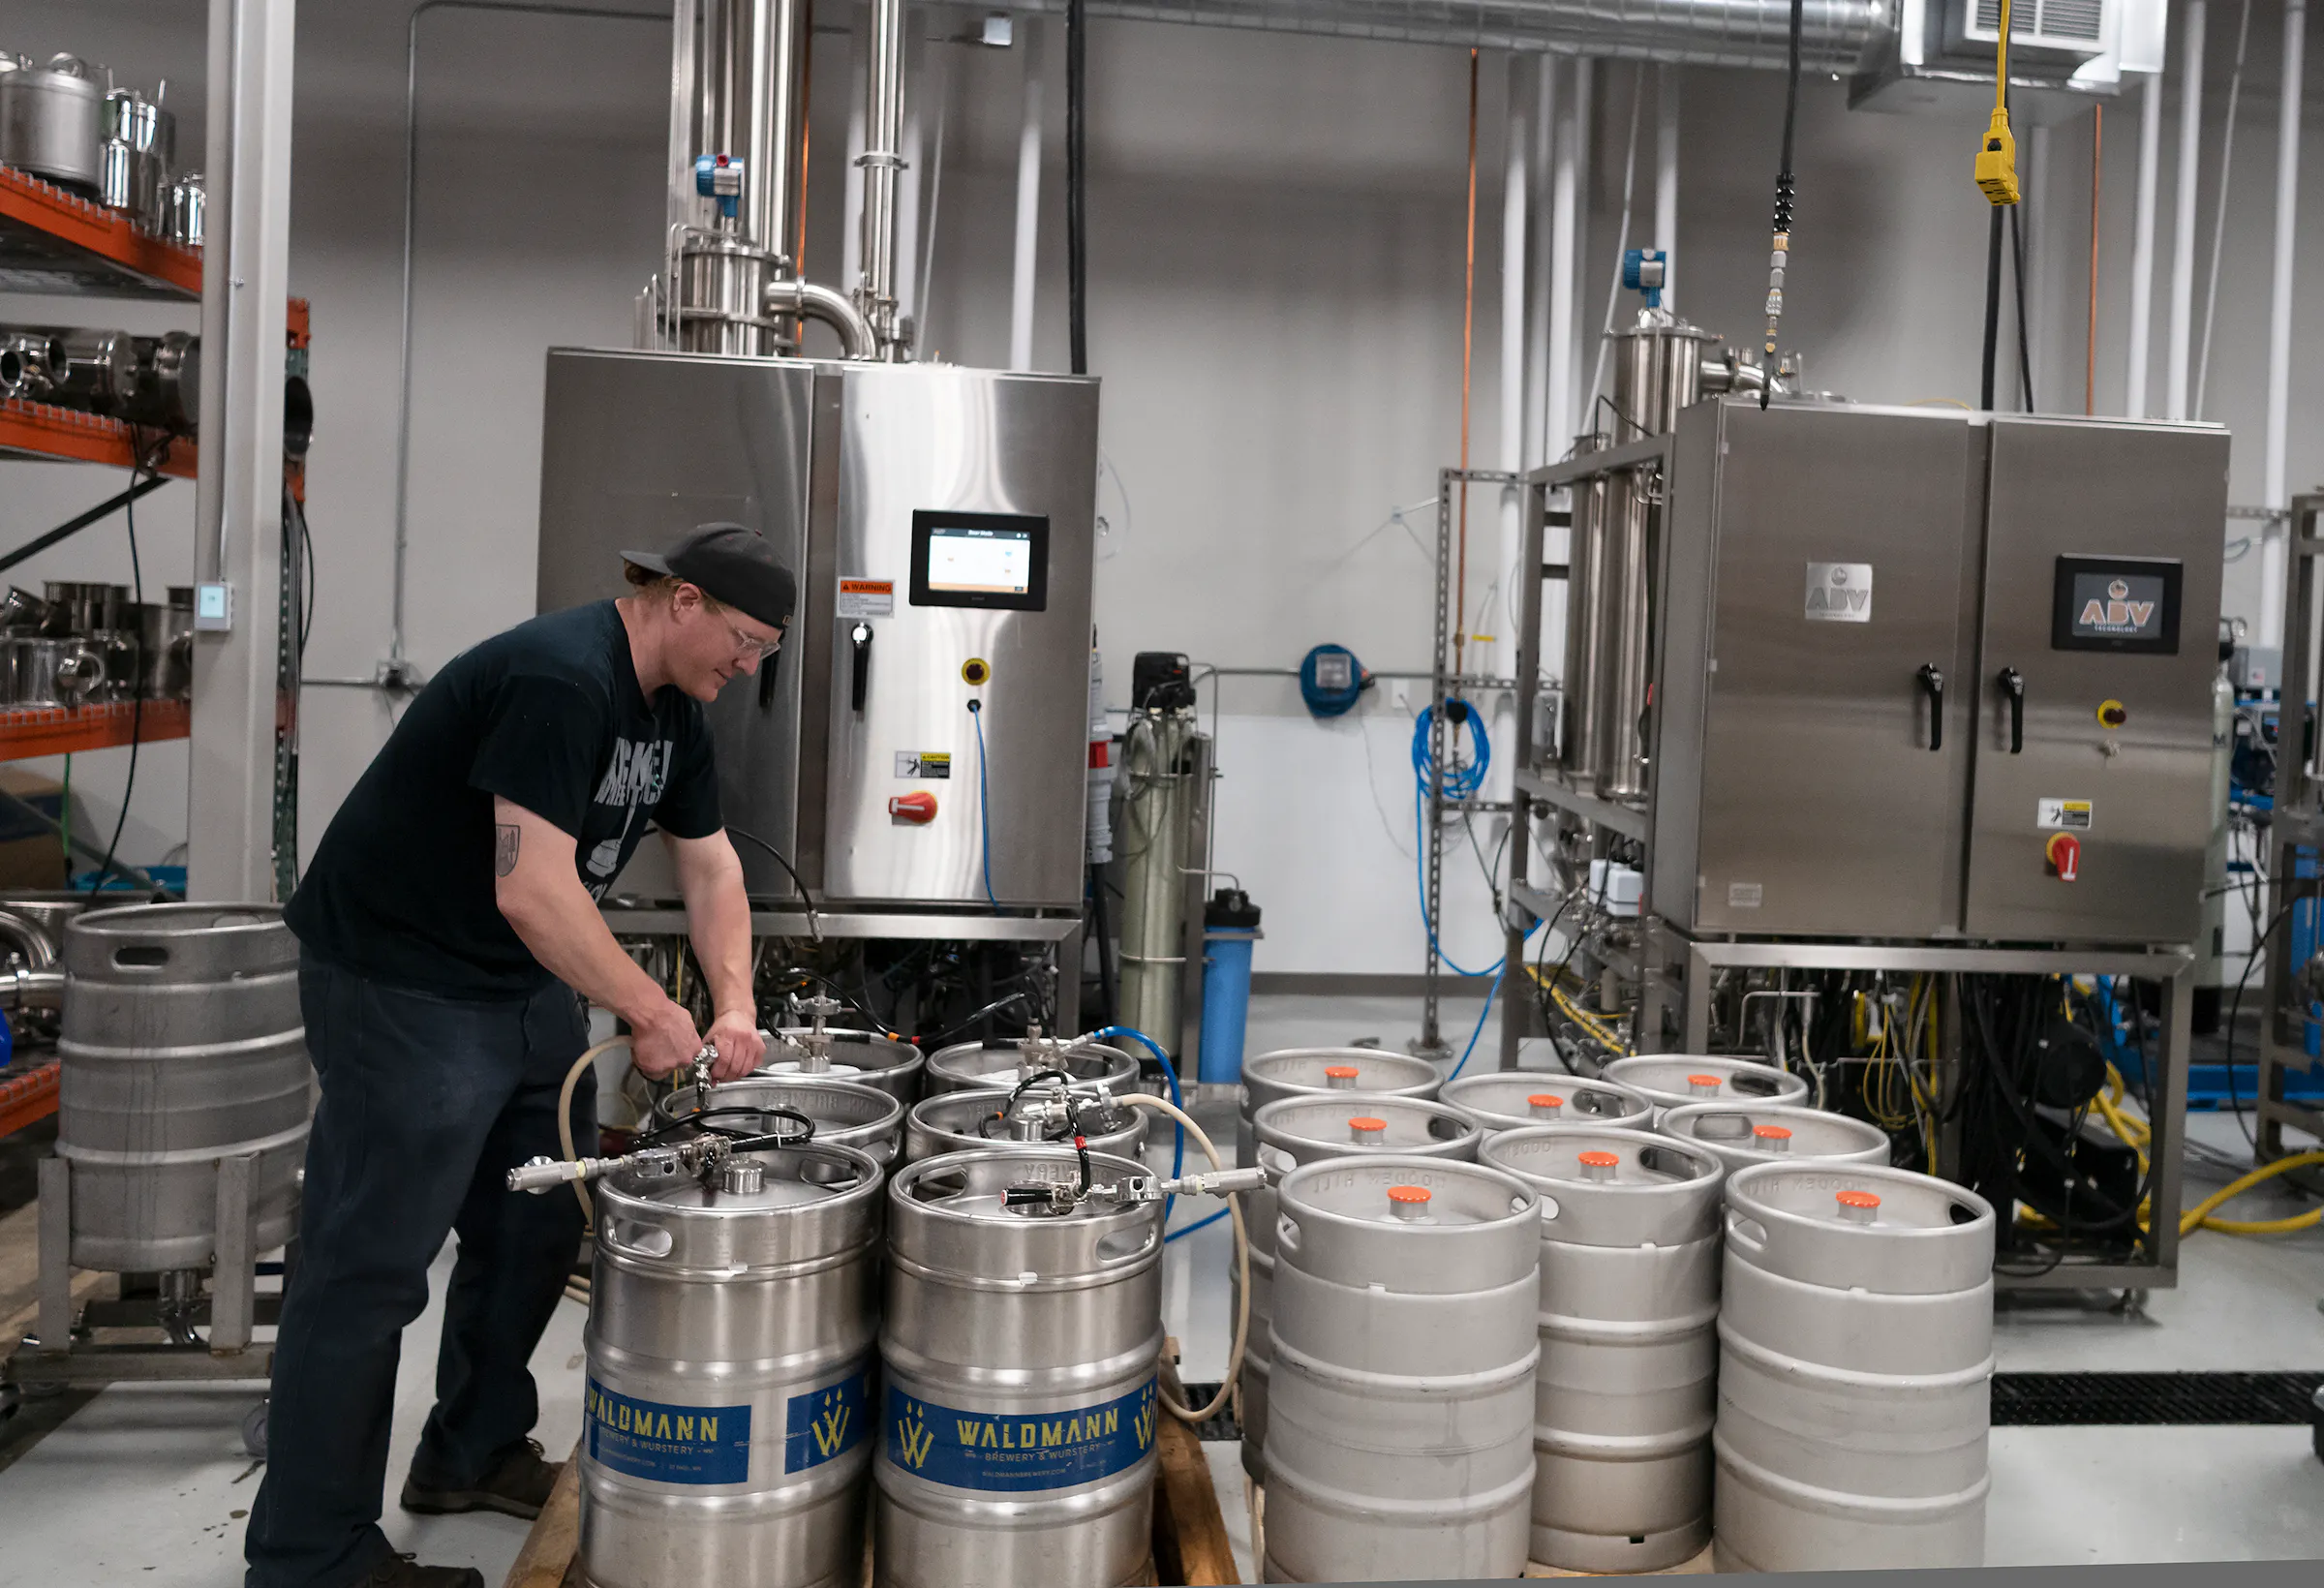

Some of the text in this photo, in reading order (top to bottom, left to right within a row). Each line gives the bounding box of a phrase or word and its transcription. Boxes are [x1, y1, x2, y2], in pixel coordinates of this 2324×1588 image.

[851, 583, 891, 592] WARNING
[1806, 586, 1869, 611] ABV
[2078, 597, 2156, 627] ABV
[588, 1385, 719, 1442] WALDMANN
[957, 1407, 1118, 1449] WALDMANN
[640, 1441, 693, 1455] WURSTERY
[985, 1451, 1034, 1463] BREWERY
[1038, 1451, 1046, 1461] &
[1049, 1443, 1101, 1459] WURSTERY
